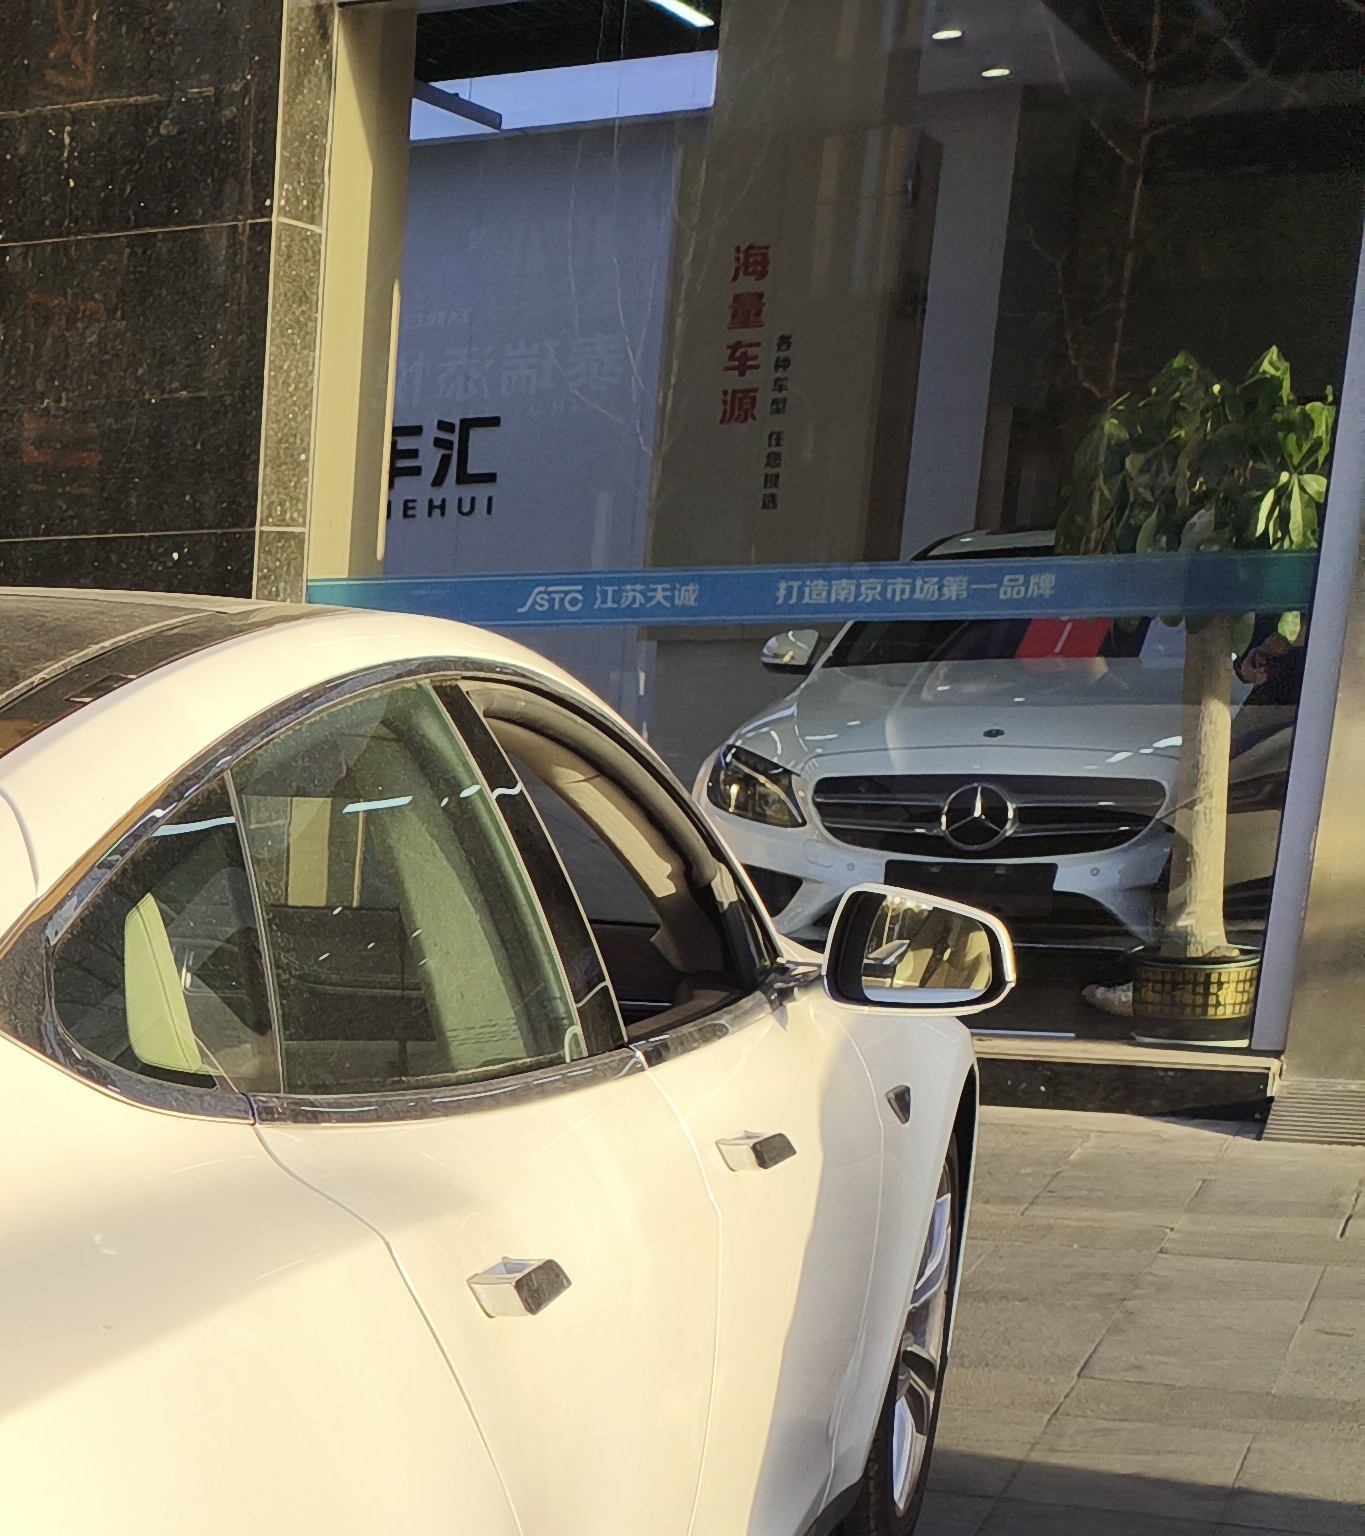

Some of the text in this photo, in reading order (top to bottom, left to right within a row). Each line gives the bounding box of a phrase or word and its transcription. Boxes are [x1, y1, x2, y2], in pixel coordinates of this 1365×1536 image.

[719, 244, 771, 425] 海量车源
[593, 581, 699, 610] 江苏天诚
[775, 572, 1058, 605] 打造南京市场第一品牌
